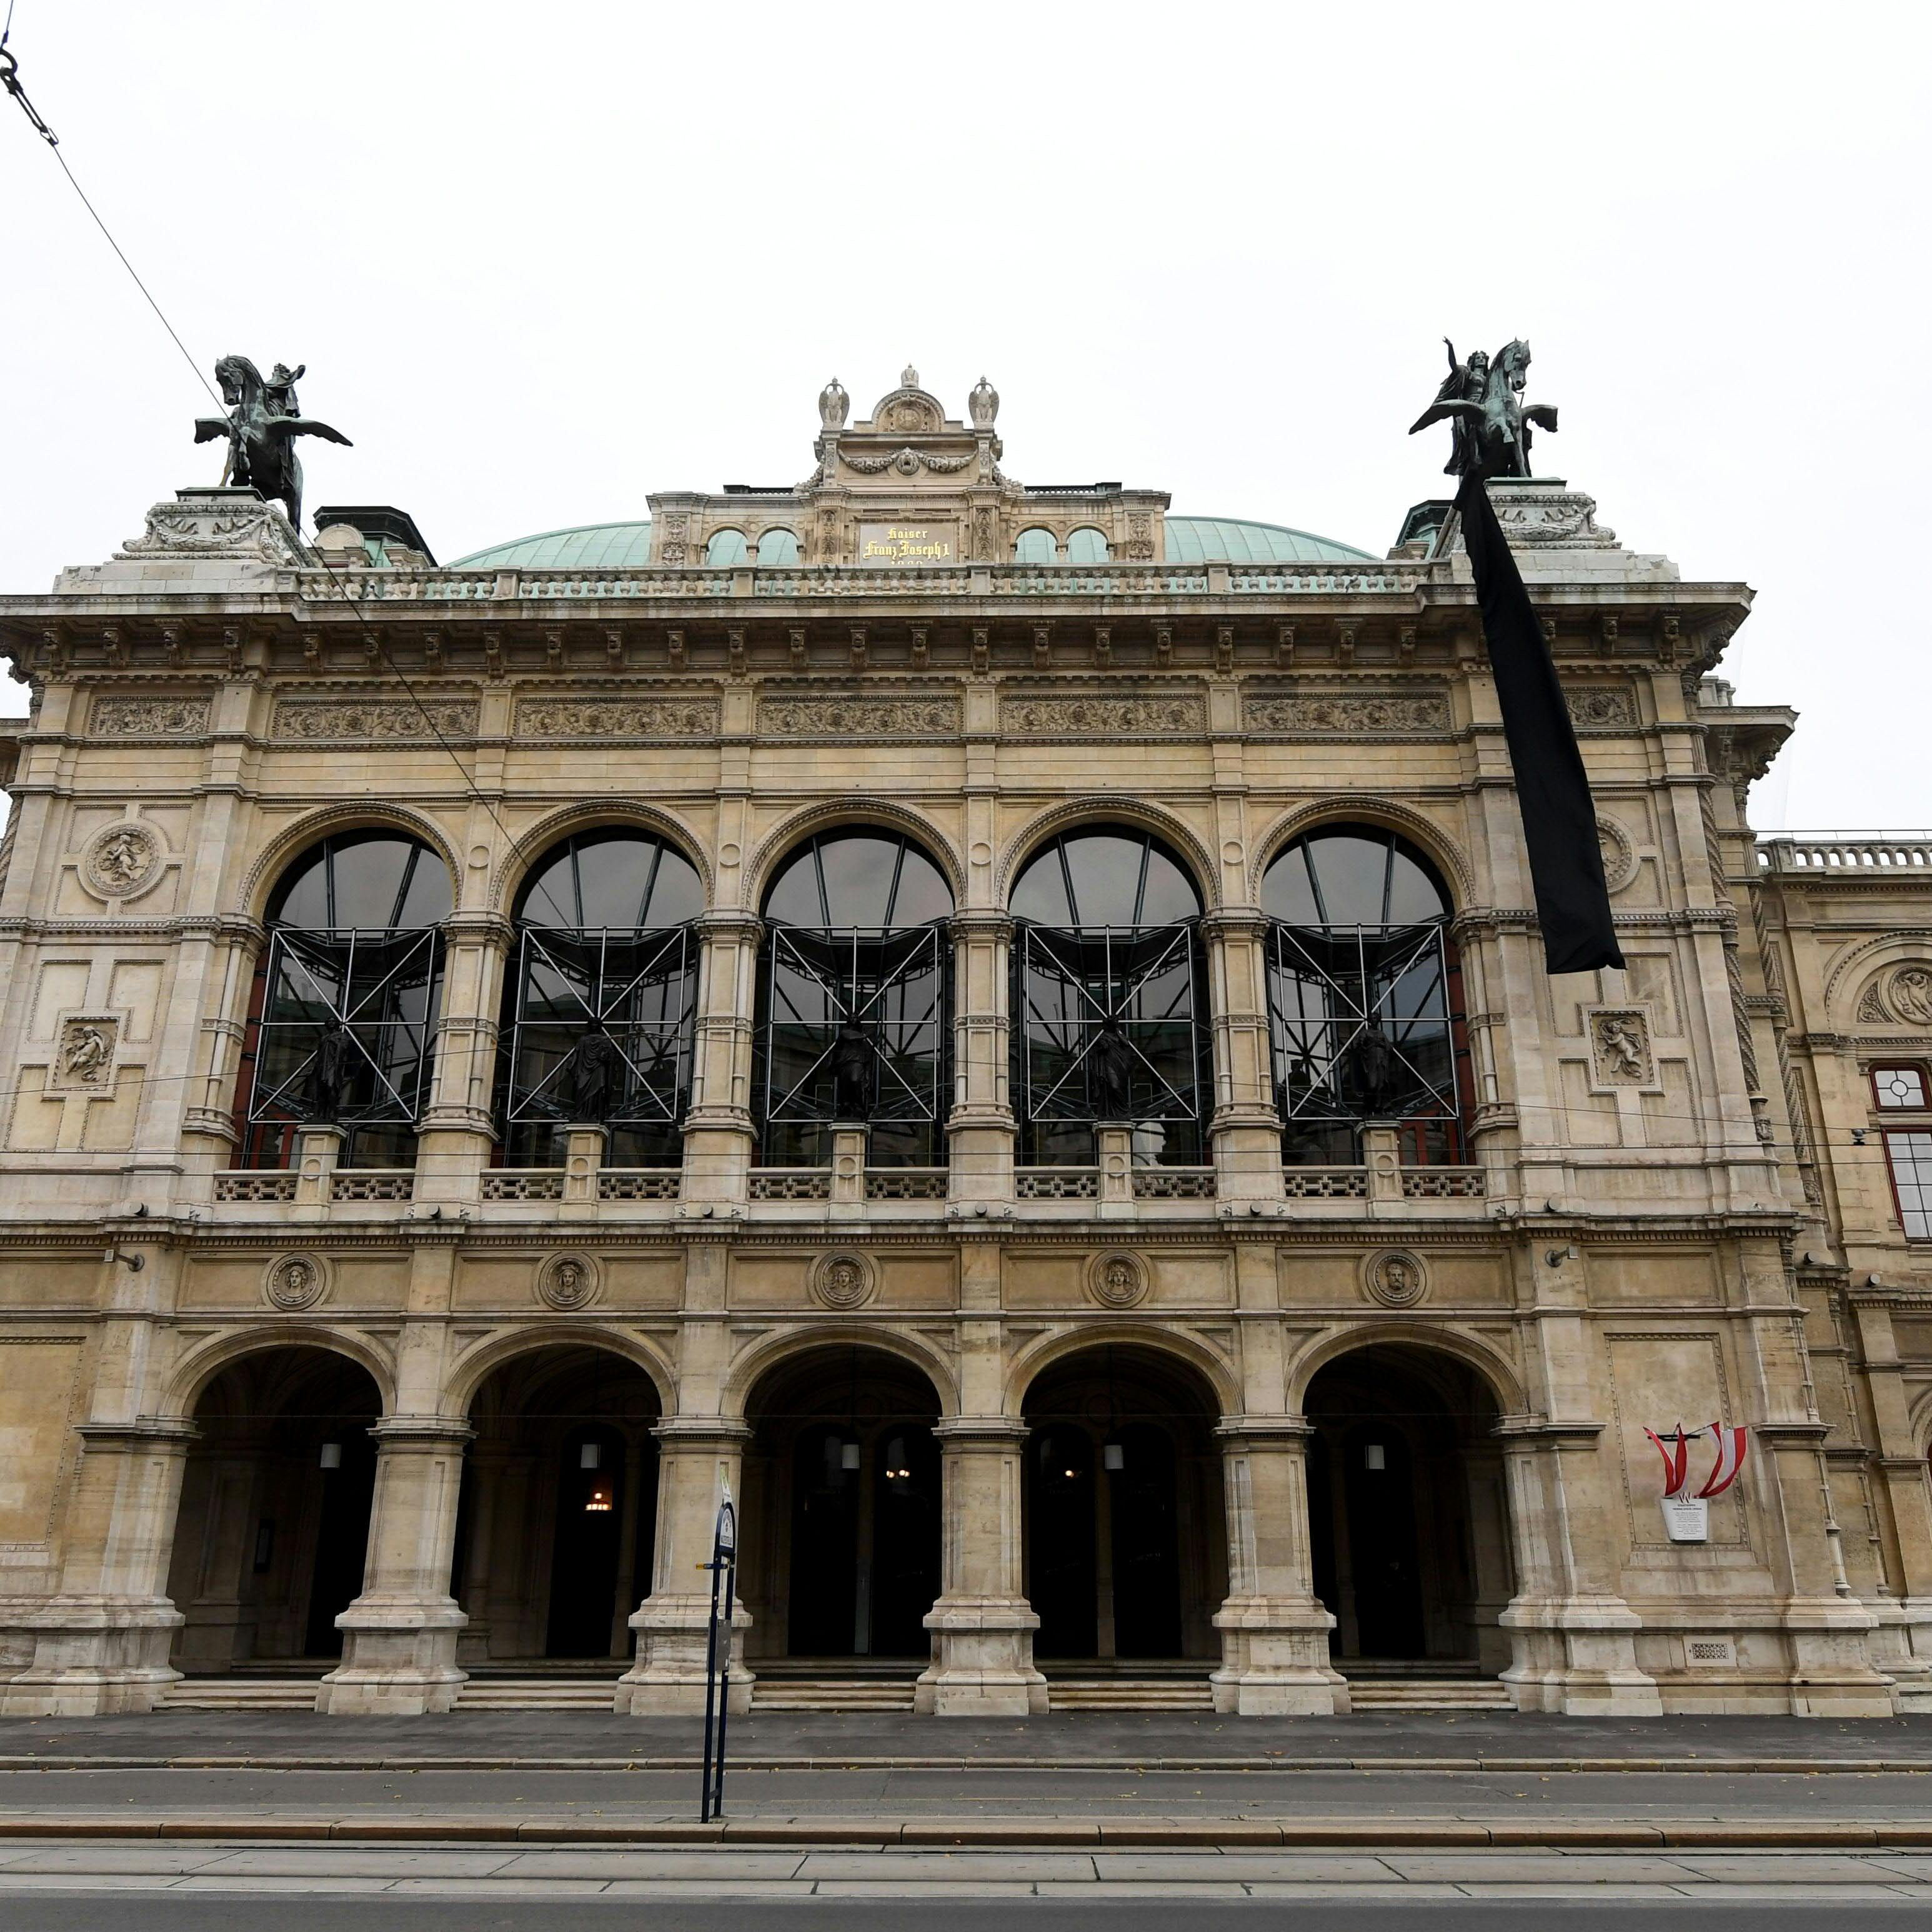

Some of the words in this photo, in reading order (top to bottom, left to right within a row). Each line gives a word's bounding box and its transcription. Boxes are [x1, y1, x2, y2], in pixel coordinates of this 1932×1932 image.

[887, 528, 928, 540] Kaiser
[863, 540, 897, 560] Franz
[899, 540, 941, 560] Joseph
